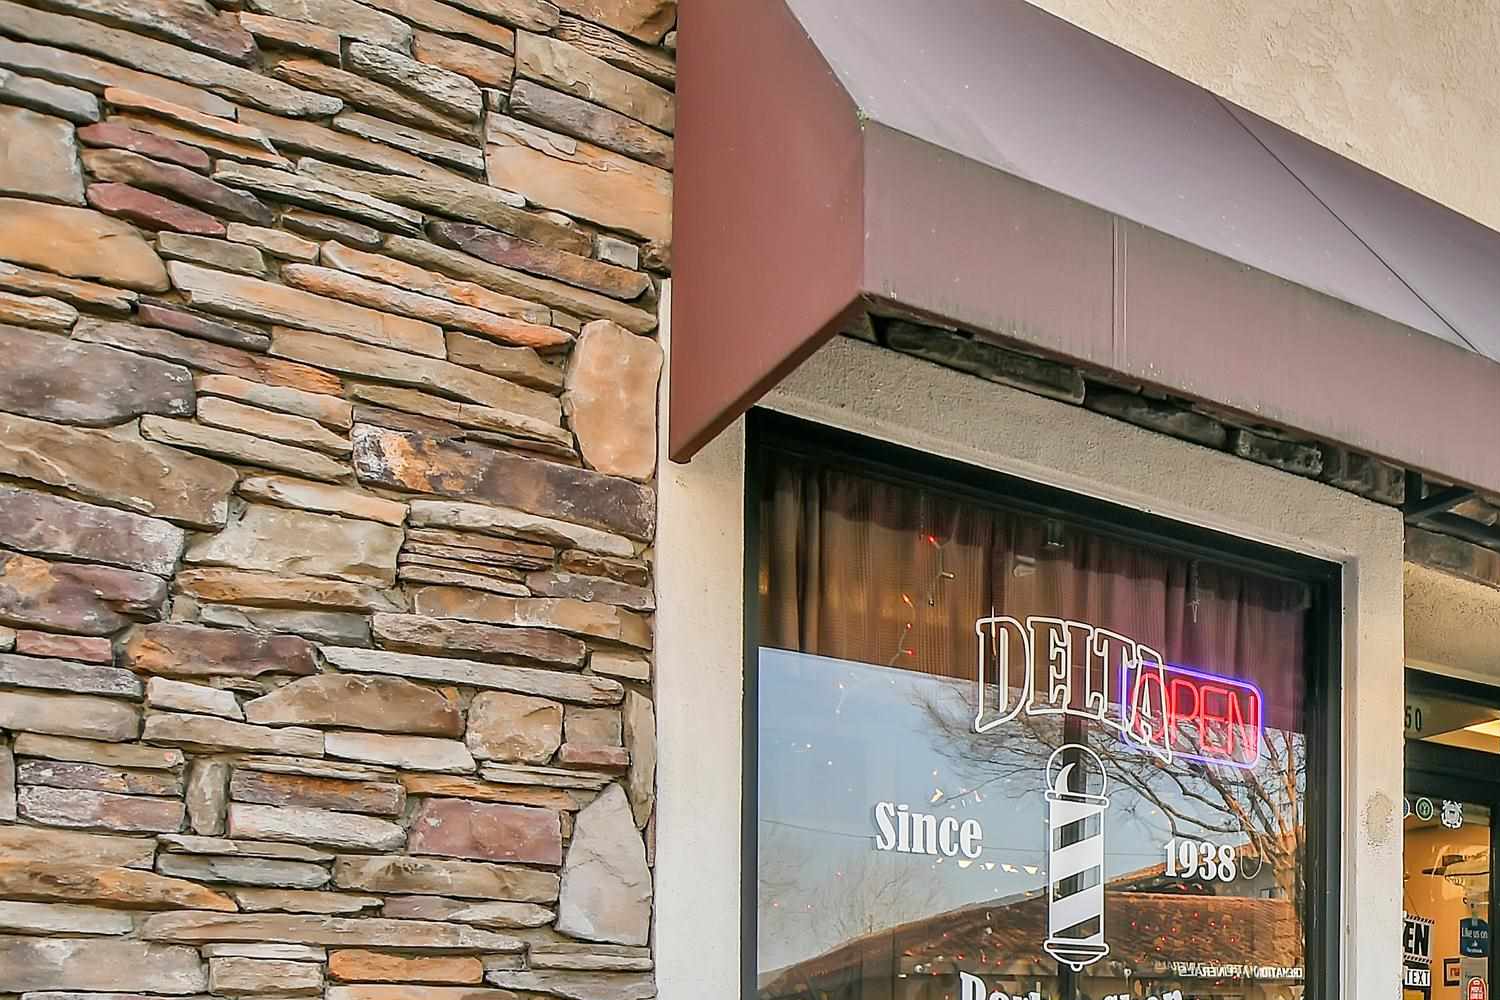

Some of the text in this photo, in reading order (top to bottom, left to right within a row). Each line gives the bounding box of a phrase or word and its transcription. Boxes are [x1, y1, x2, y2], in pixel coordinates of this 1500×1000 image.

[975, 615, 1172, 764] DELTA
[1129, 671, 1258, 766] OPEN
[874, 800, 983, 859] Since
[1162, 837, 1237, 883] 1938
